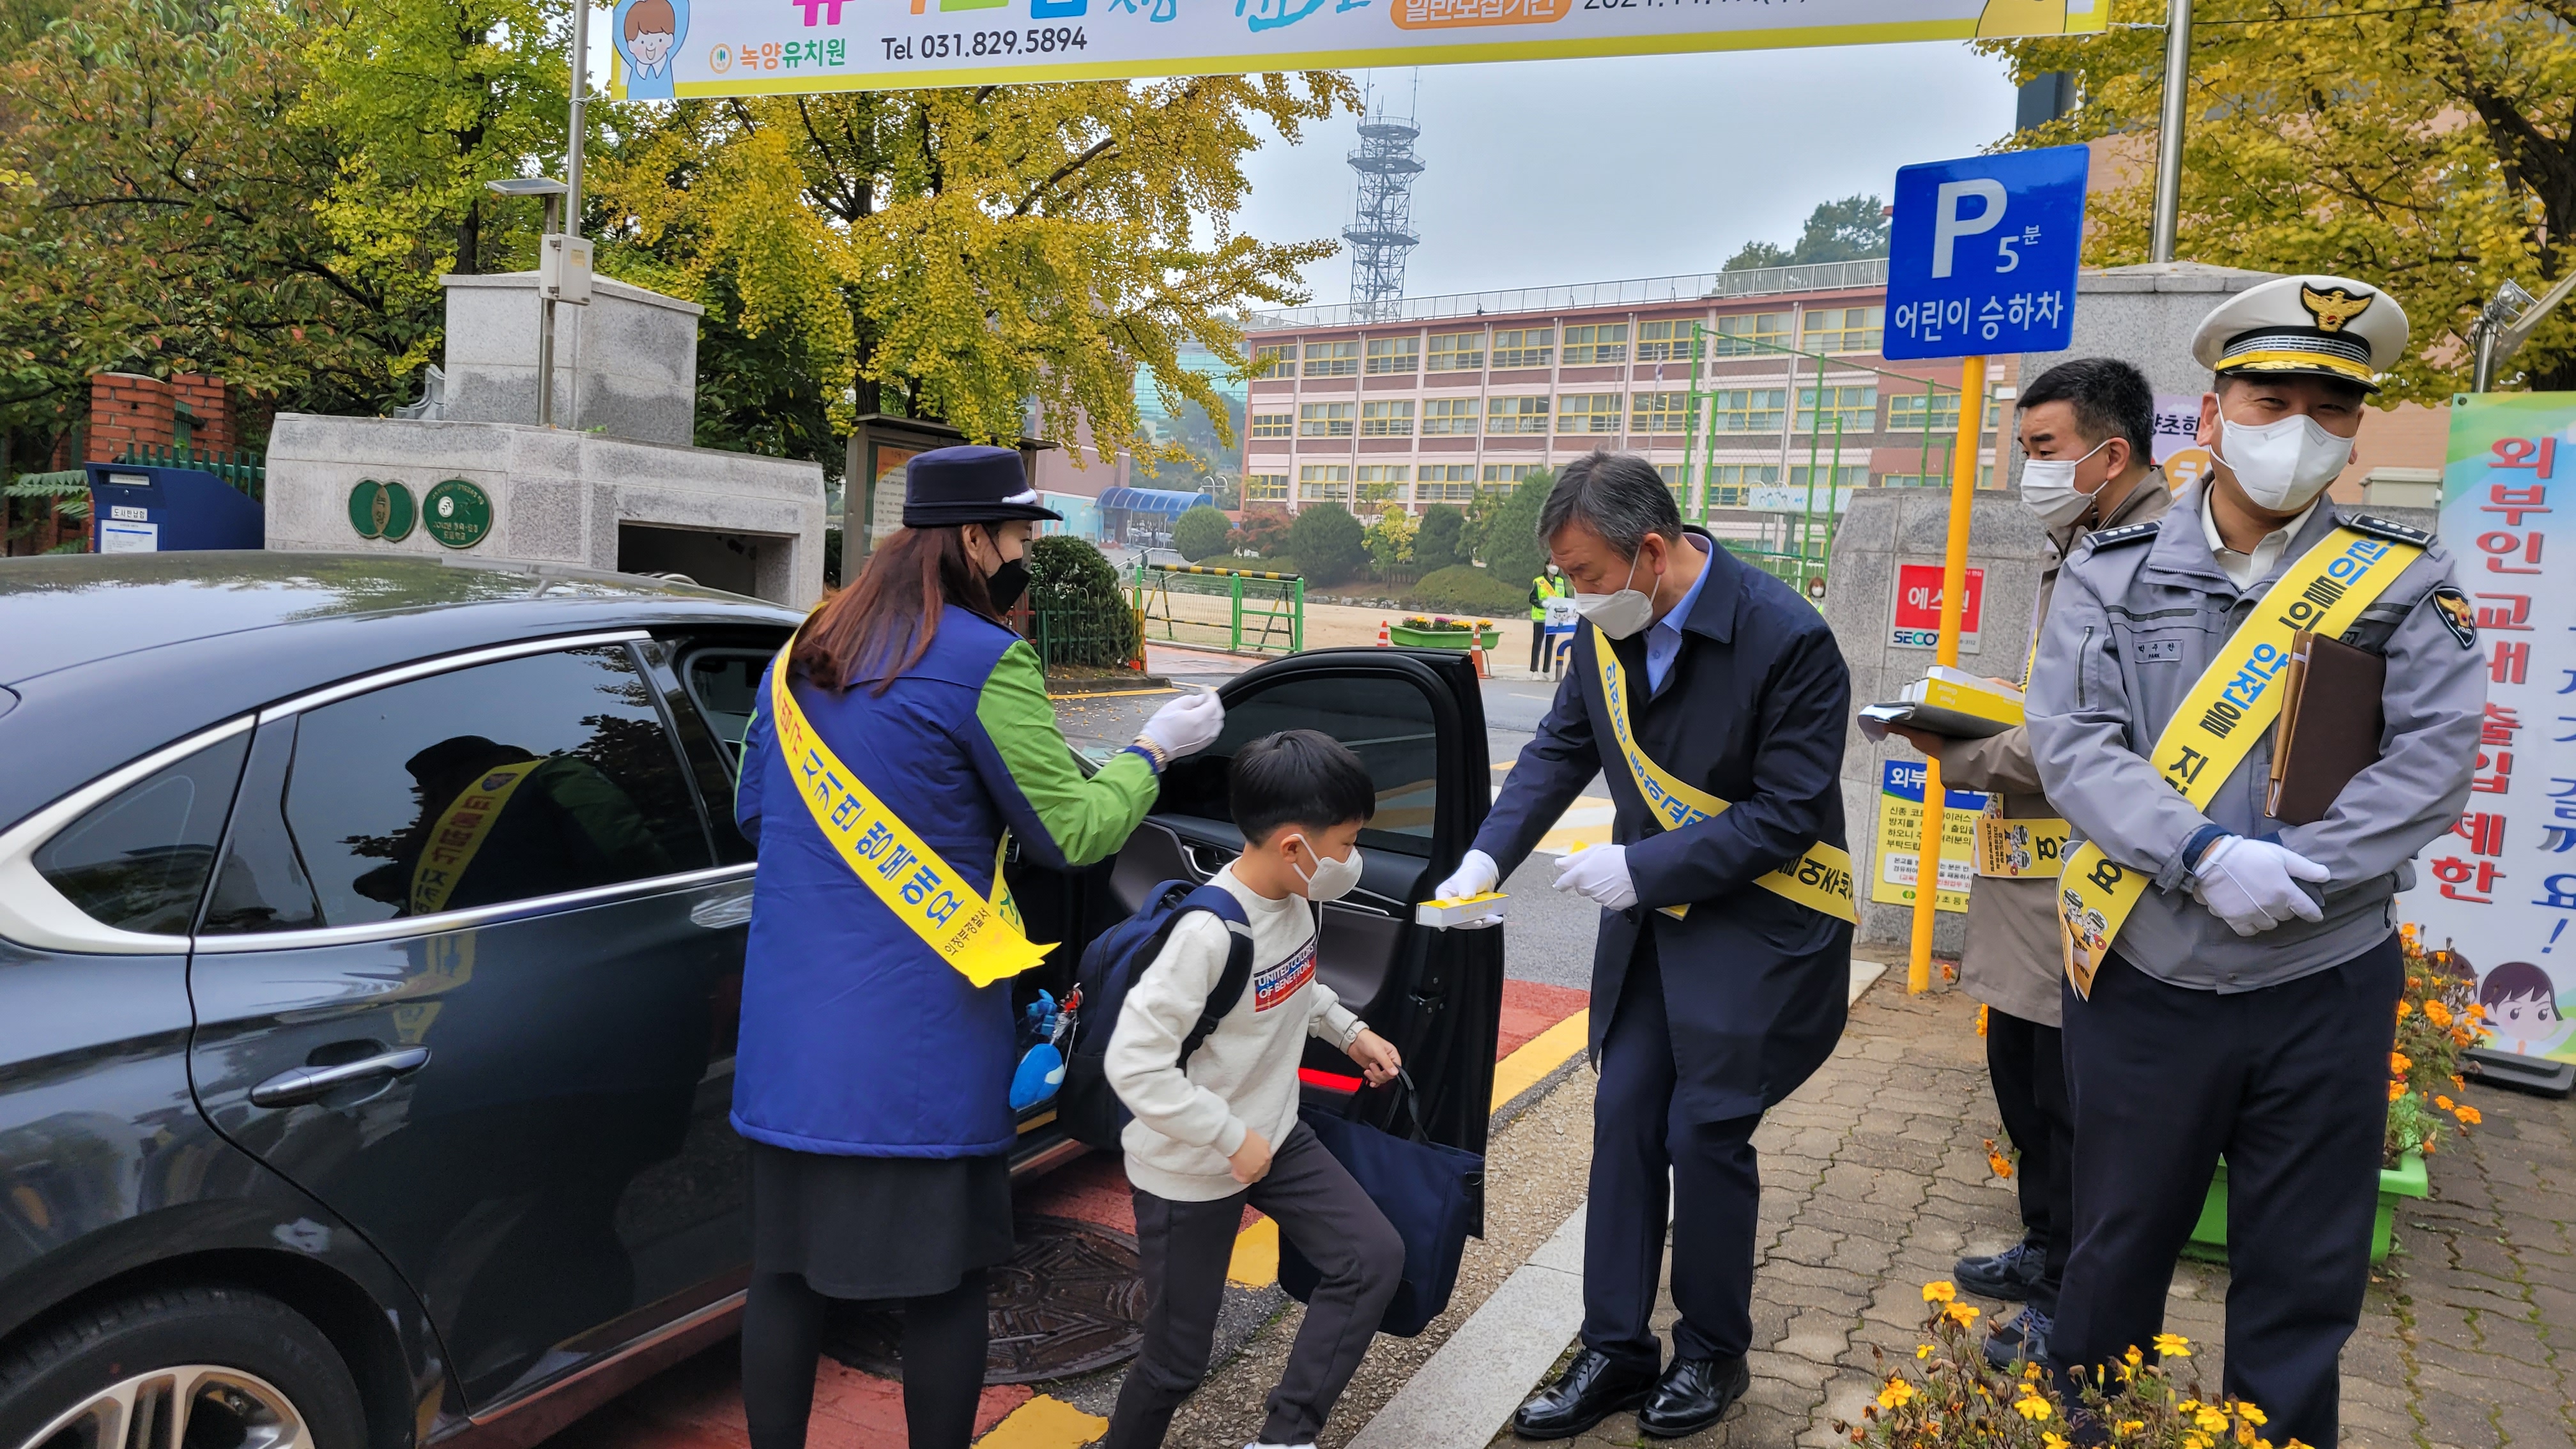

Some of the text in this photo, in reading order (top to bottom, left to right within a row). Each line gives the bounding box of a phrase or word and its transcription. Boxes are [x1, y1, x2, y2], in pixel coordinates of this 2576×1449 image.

[740, 38, 845, 70] 녹양유치원
[881, 26, 1087, 60] Tel 031.829.5894
[1931, 178, 2007, 279] P
[1895, 290, 2064, 342] 어린이 승하차
[114, 508, 145, 519] 도서반납함
[2476, 436, 2557, 574] 외부인
[2278, 535, 2398, 632] 린이들의
[1893, 631, 1940, 646] SECO
[2198, 643, 2289, 740] 안전을
[1943, 812, 1972, 823] 이러스
[801, 748, 866, 832] 지키면
[854, 820, 965, 930] 행복해요
[944, 907, 992, 956] 의정부경찰서
[1258, 965, 1290, 986] UNITED
[1258, 985, 1273, 999] OF
